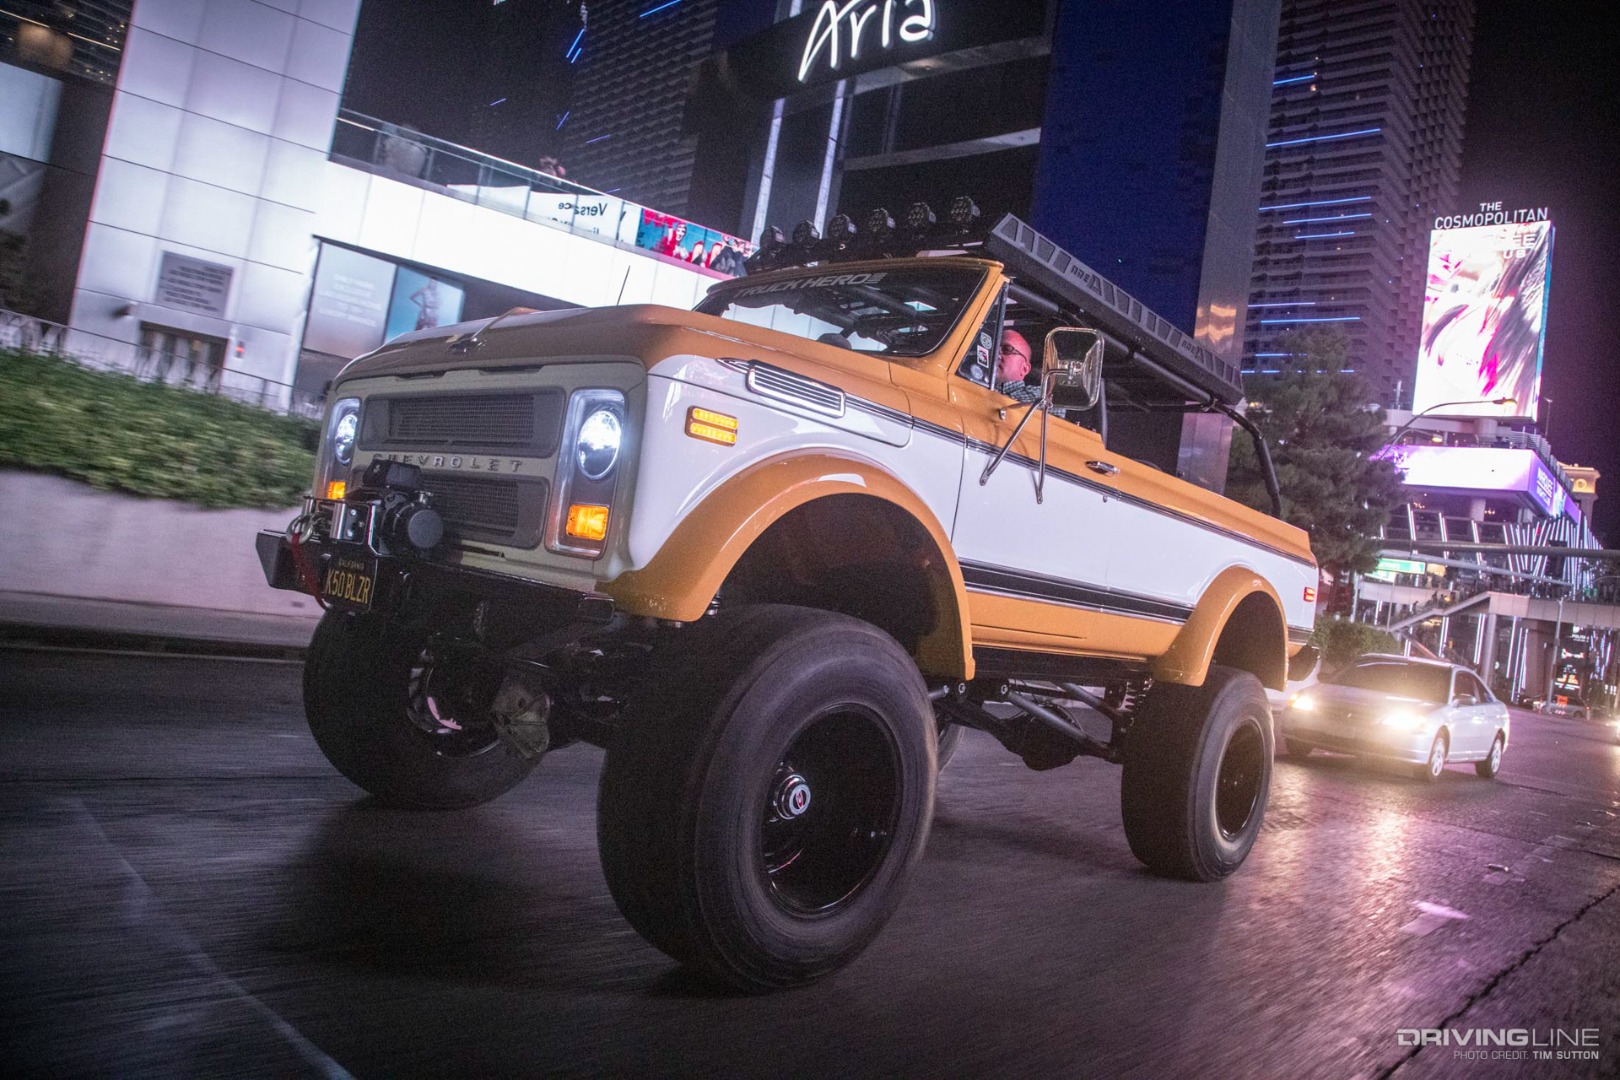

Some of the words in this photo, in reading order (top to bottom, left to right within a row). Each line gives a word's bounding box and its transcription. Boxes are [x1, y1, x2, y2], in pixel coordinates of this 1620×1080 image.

[798, 0, 934, 82] Aria
[1480, 201, 1502, 212] THE
[1435, 208, 1548, 229] COSMOPOLITAN
[733, 281, 801, 298] TRUCK
[801, 274, 870, 288] HERO
